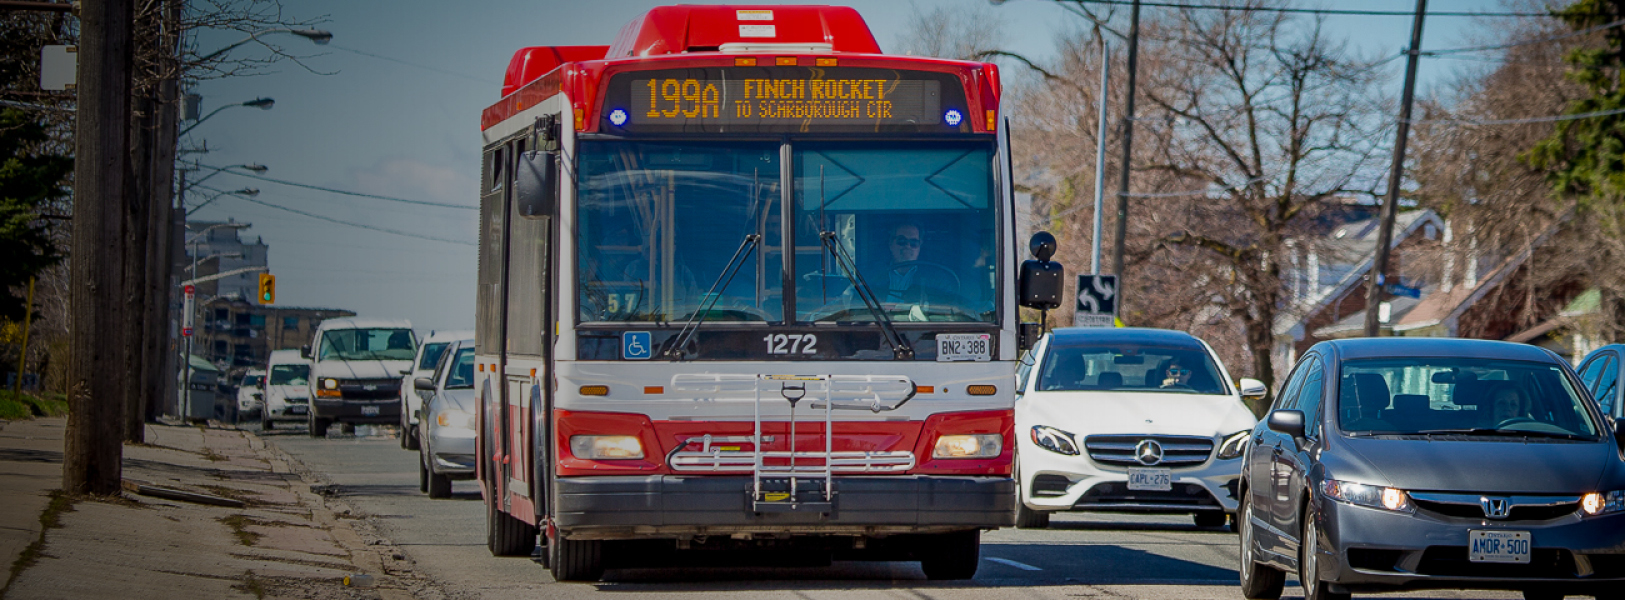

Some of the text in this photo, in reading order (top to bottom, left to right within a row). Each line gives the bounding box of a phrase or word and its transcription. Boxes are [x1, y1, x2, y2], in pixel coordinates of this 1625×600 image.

[646, 78, 719, 118] 199A
[744, 79, 887, 99] FINCH ROCKET
[735, 100, 893, 118] TO SCARBOROUGH CTR
[763, 333, 817, 354] 1272
